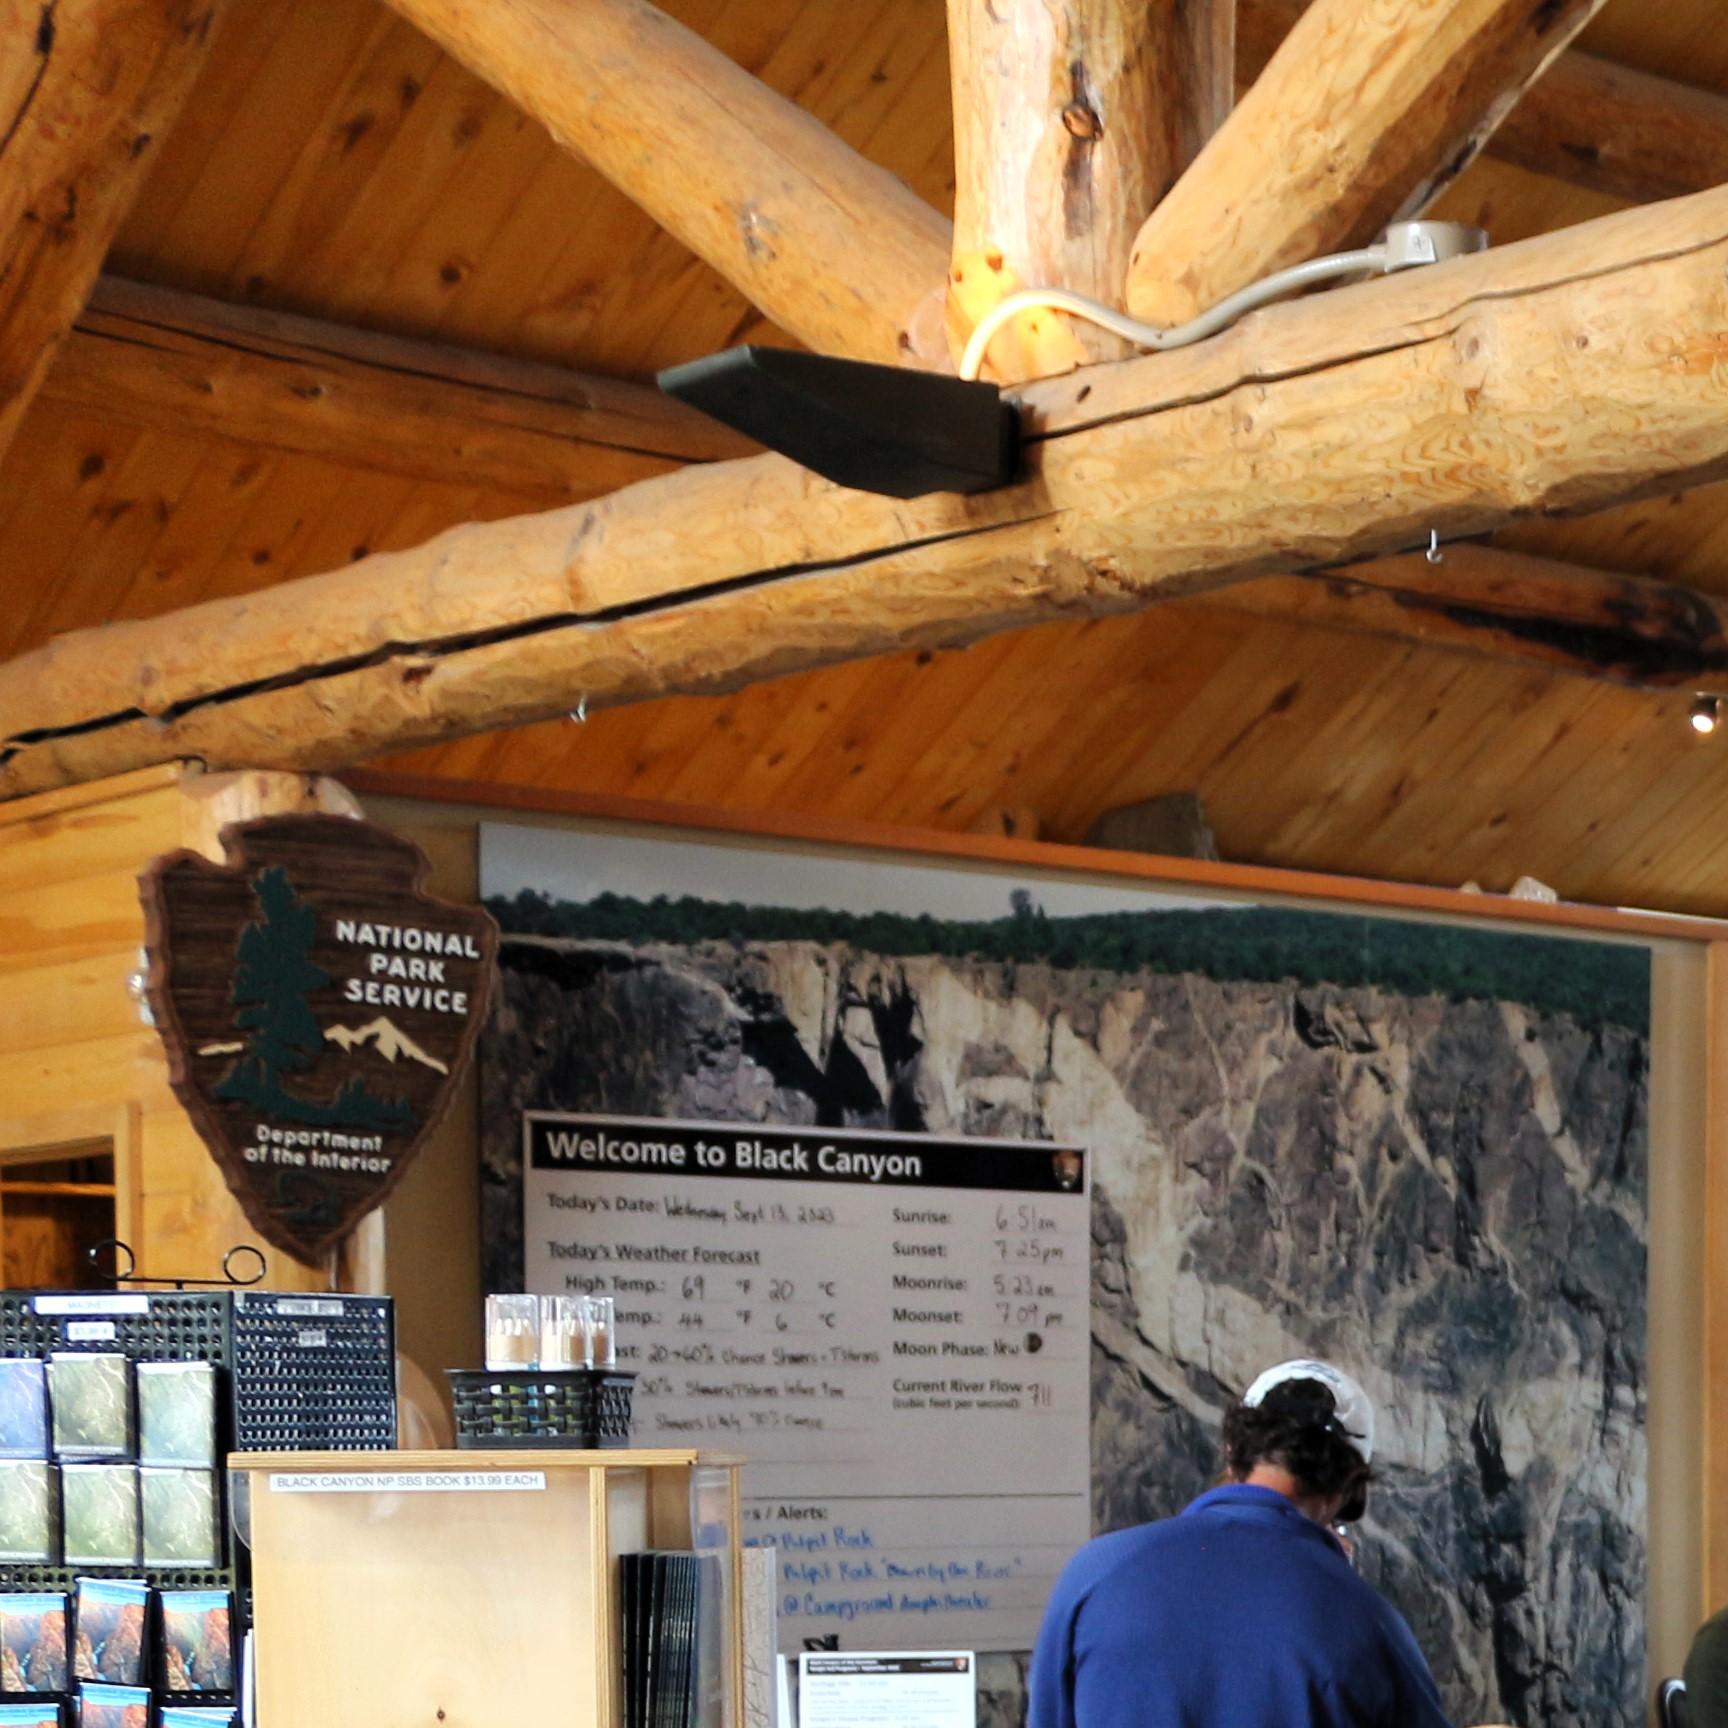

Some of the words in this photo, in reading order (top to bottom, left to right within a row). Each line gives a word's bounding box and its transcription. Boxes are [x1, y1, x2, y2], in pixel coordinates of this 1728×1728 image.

[336, 919, 480, 959] NATIONAL
[370, 954, 446, 984] PARK
[343, 978, 468, 1014] SERVICE
[256, 1124, 383, 1152] Department
[244, 1144, 268, 1164] of
[272, 1146, 304, 1167] the
[309, 1150, 391, 1175] Interior
[546, 1131, 687, 1166] Welcome
[695, 1139, 726, 1168] to
[734, 1141, 809, 1172] Black
[817, 1144, 922, 1182] Canyon
[547, 1194, 610, 1216] Today's
[615, 1197, 660, 1215] Date:
[893, 1208, 951, 1226] Sunrise:
[547, 1242, 610, 1261] Today's
[615, 1244, 688, 1263] Weather
[693, 1247, 760, 1266] Forecast
[893, 1243, 948, 1259] Sunset:
[565, 1275, 604, 1295] High
[609, 1277, 665, 1297] Temp.:
[768, 1279, 795, 1301] 20
[892, 1275, 967, 1294] Moonrise:
[892, 1308, 963, 1326] Moonset:
[893, 1341, 938, 1358] Moon
[942, 1343, 989, 1360] Phase:
[893, 1379, 944, 1395] Current
[947, 1380, 986, 1395] River
[989, 1380, 1021, 1395] Flow
[277, 1477, 317, 1488] BLACK
[321, 1476, 374, 1488] CANYON
[377, 1477, 394, 1487] NP
[425, 1476, 461, 1487] BOOK
[504, 1475, 538, 1486] EACH
[776, 1505, 827, 1521] Alerts:
